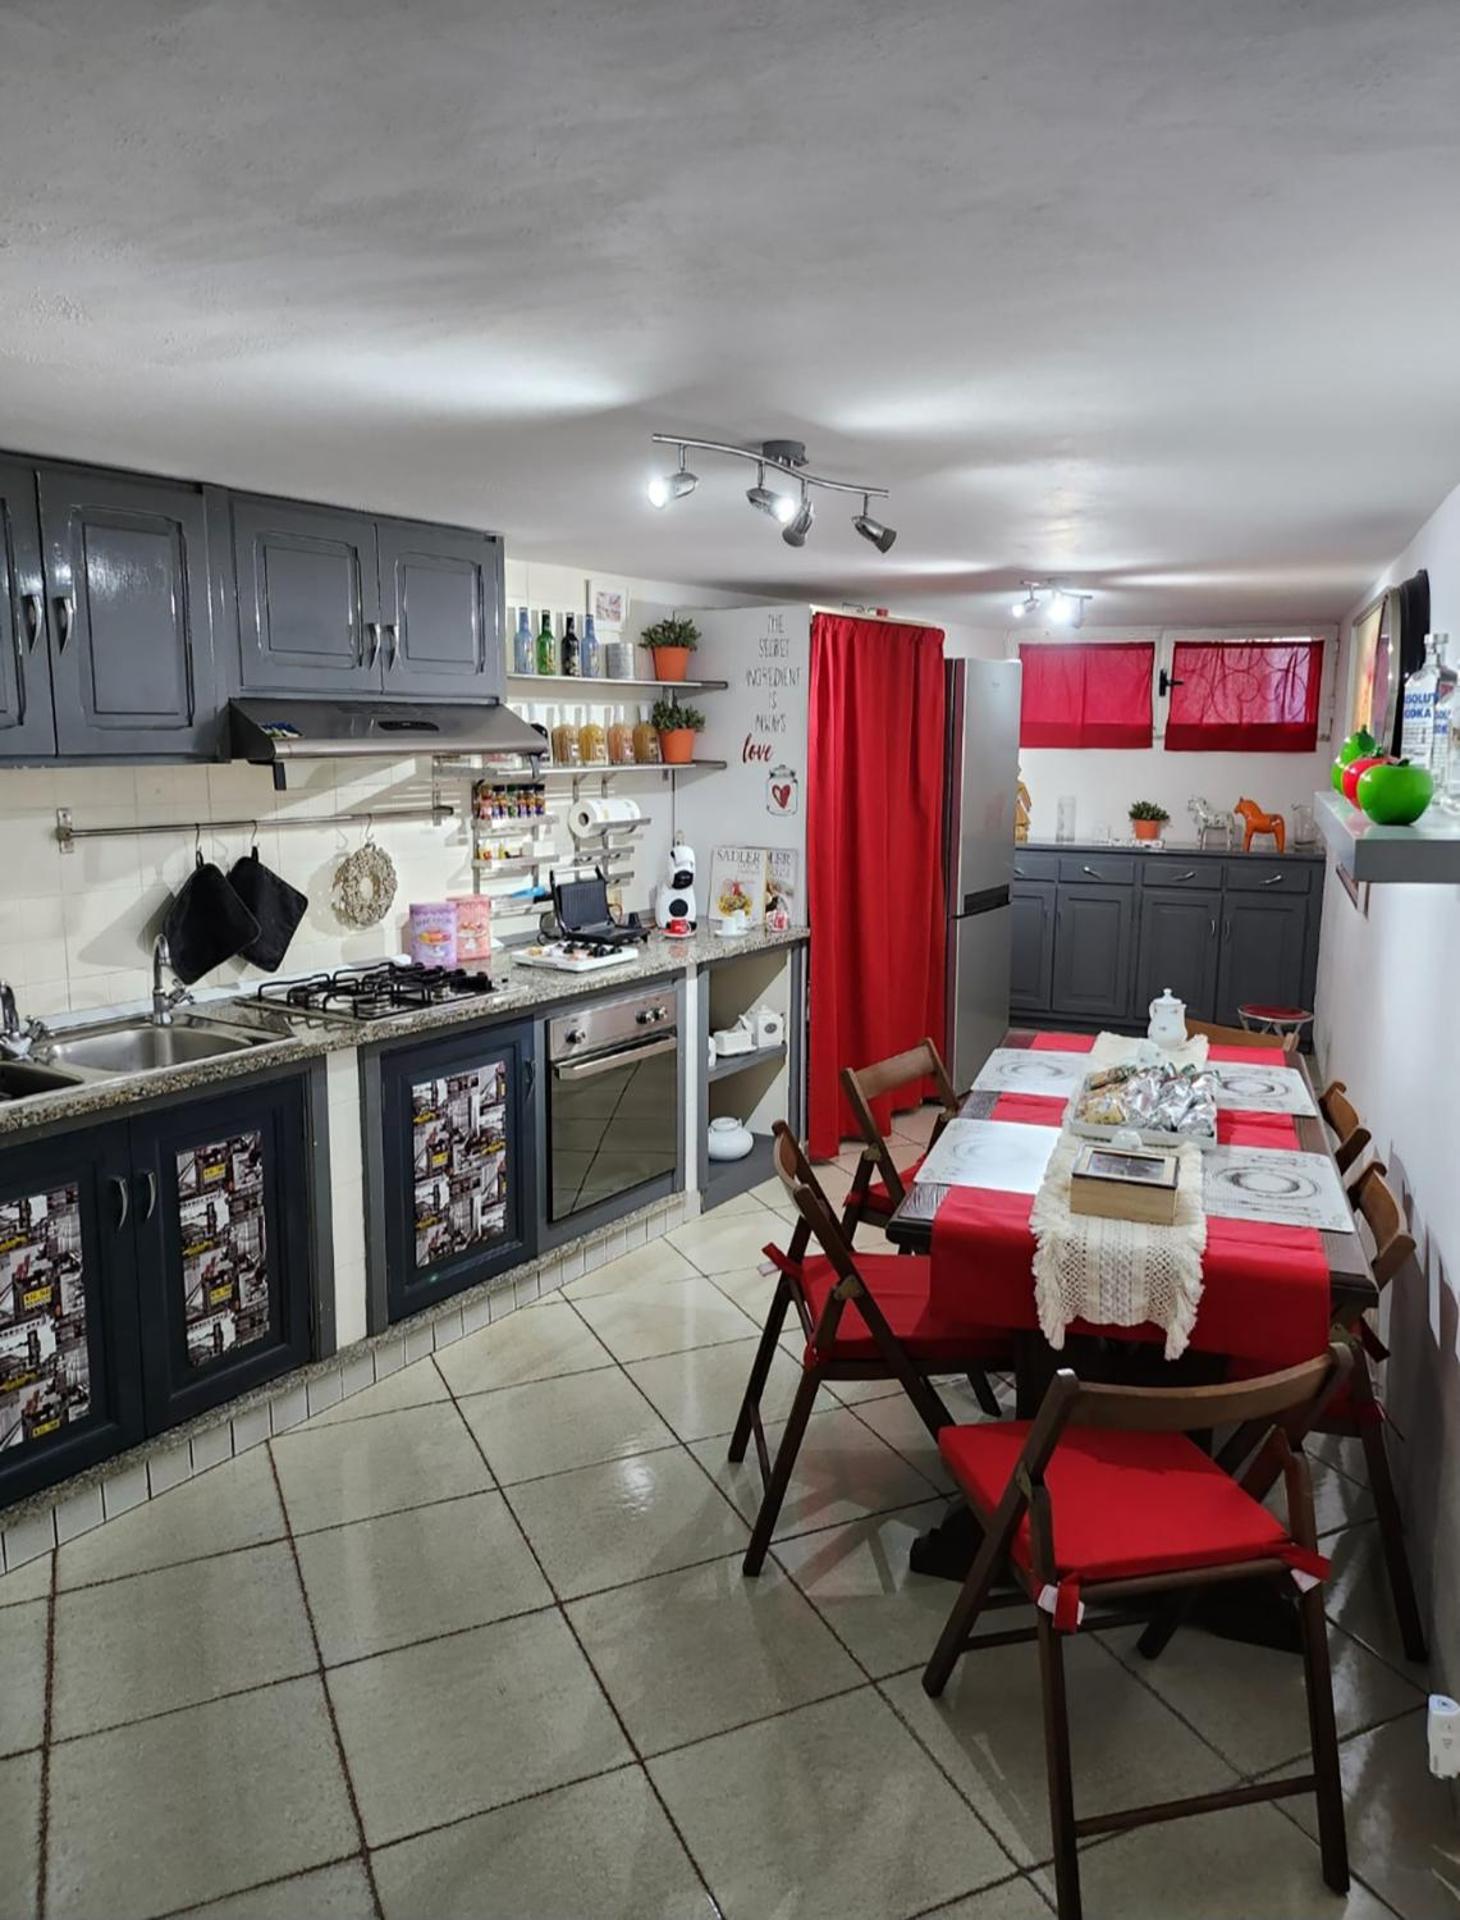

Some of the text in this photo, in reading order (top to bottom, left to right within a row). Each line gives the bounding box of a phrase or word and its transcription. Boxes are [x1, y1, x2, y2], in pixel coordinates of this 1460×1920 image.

[768, 614, 784, 633] THE
[759, 638, 789, 657] SECRET
[743, 732, 774, 763] love
[716, 848, 760, 864] SADLER
